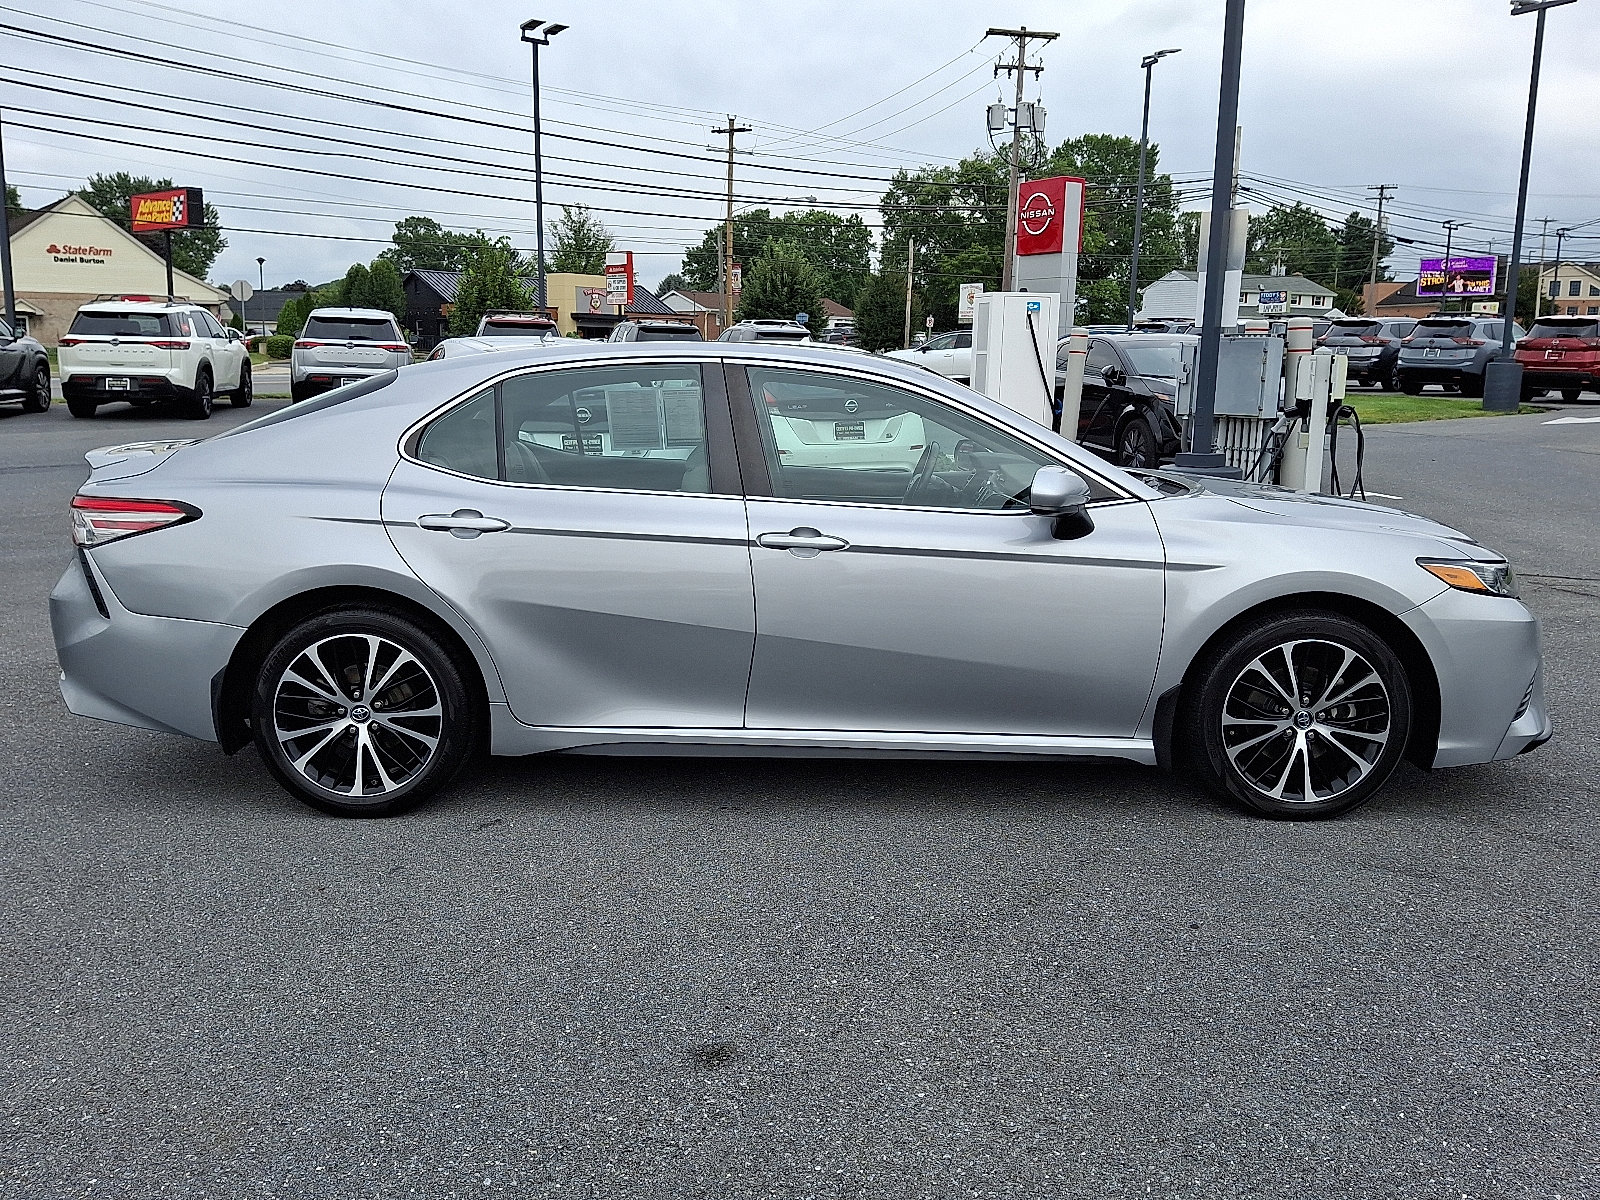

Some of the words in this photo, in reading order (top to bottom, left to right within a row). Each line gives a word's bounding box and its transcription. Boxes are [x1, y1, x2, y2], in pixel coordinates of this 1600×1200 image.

[138, 199, 170, 211] Advance
[134, 211, 151, 224] Auto
[151, 211, 171, 223] Parts
[1020, 208, 1055, 219] NISSAN
[62, 245, 87, 255] State
[88, 246, 112, 256] Farm
